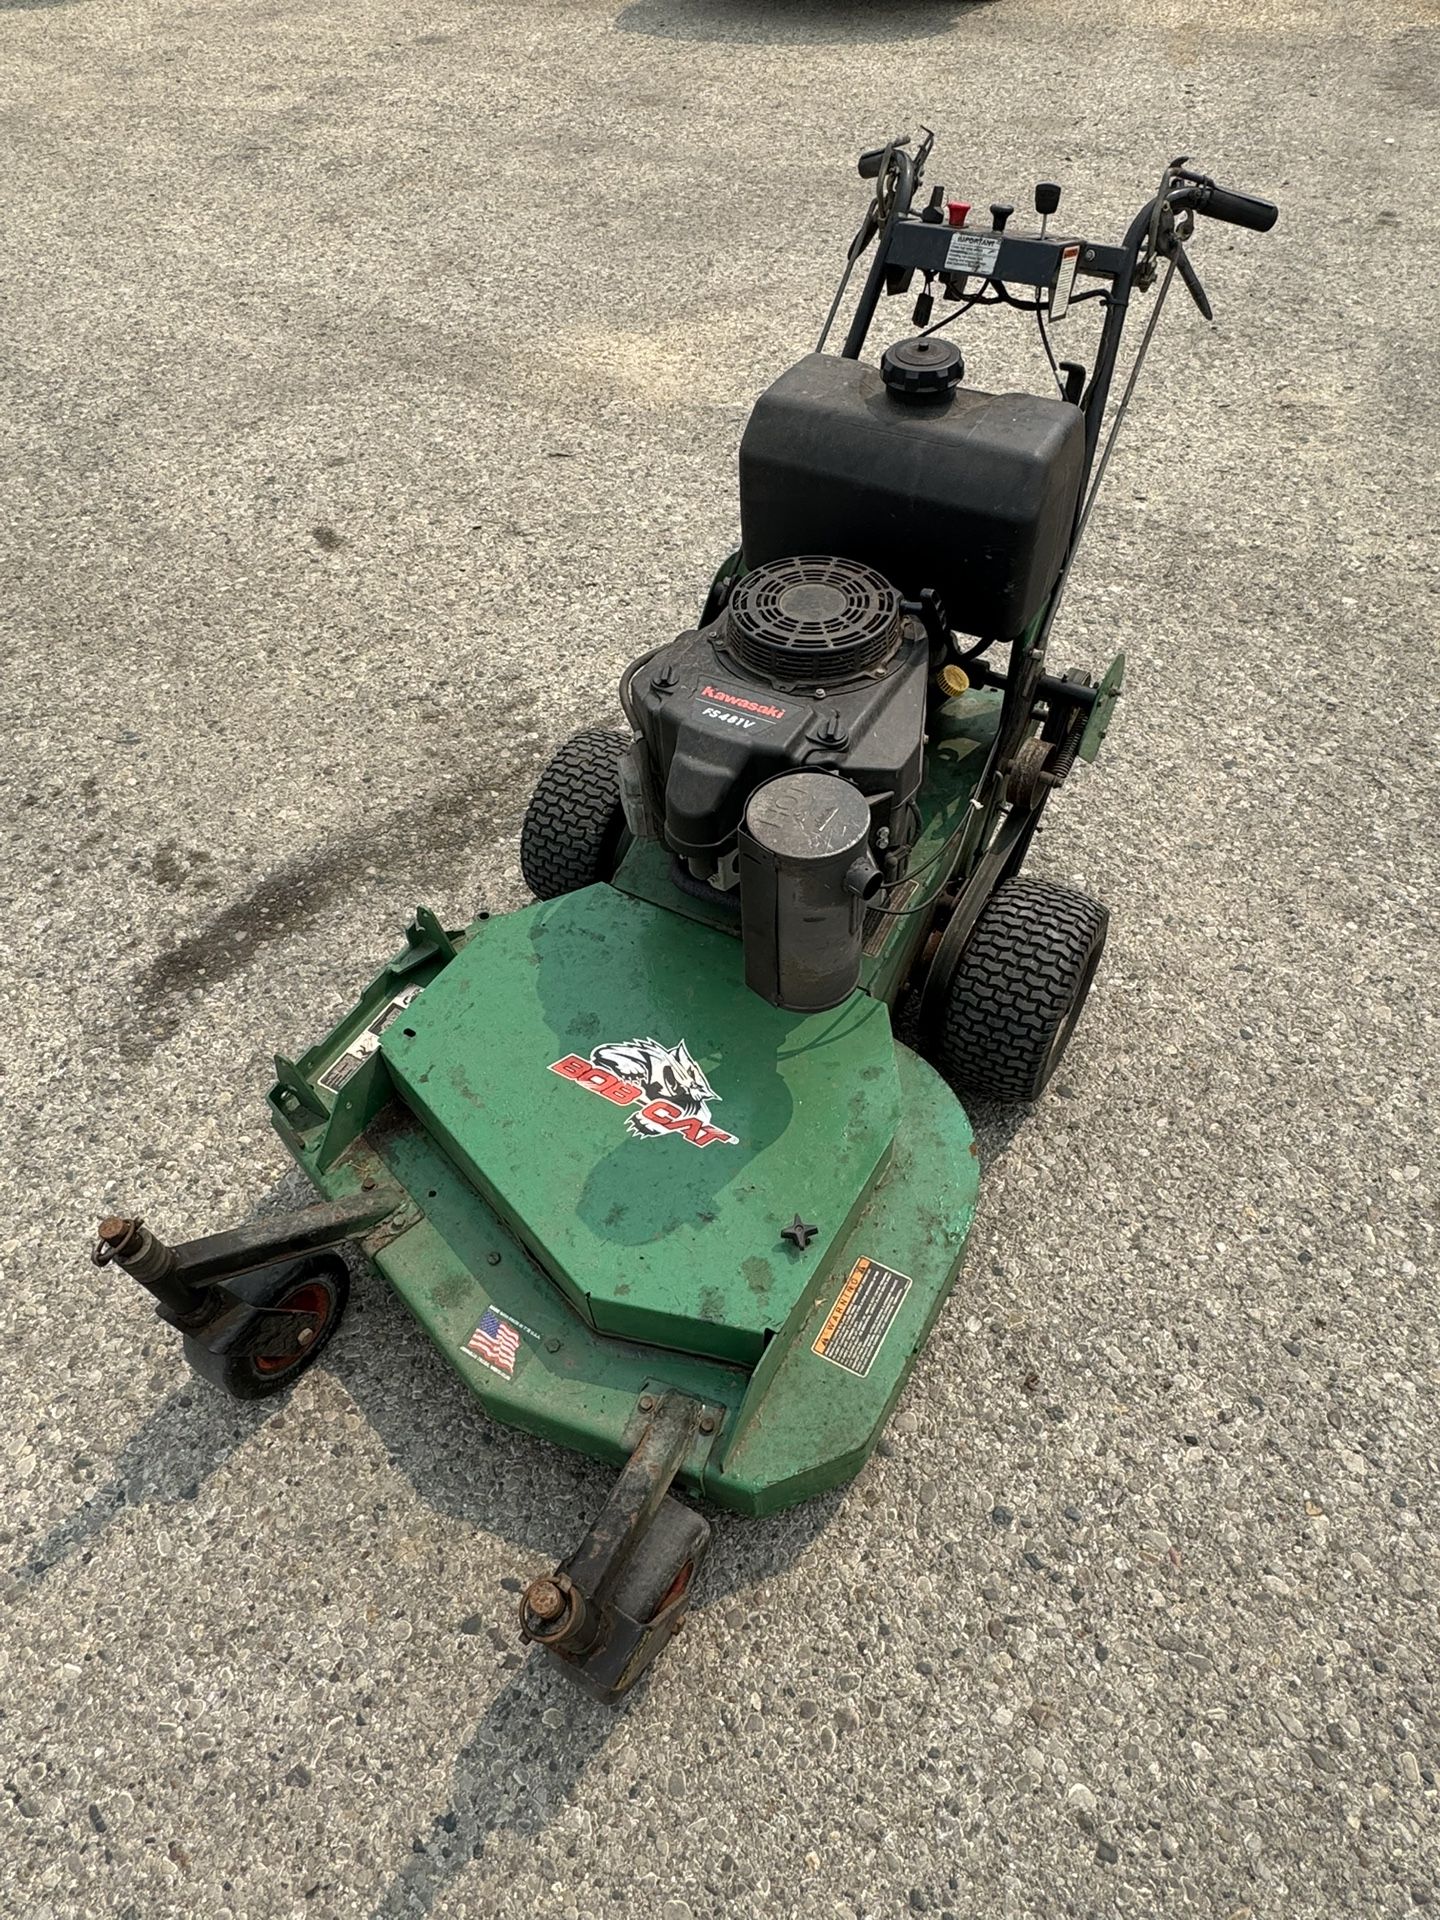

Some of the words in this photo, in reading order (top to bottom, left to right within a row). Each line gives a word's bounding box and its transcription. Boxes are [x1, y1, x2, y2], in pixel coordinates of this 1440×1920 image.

[701, 685, 787, 719] Kawasaki
[701, 707, 757, 729] FS481V
[826, 1279, 859, 1331] WARNING
